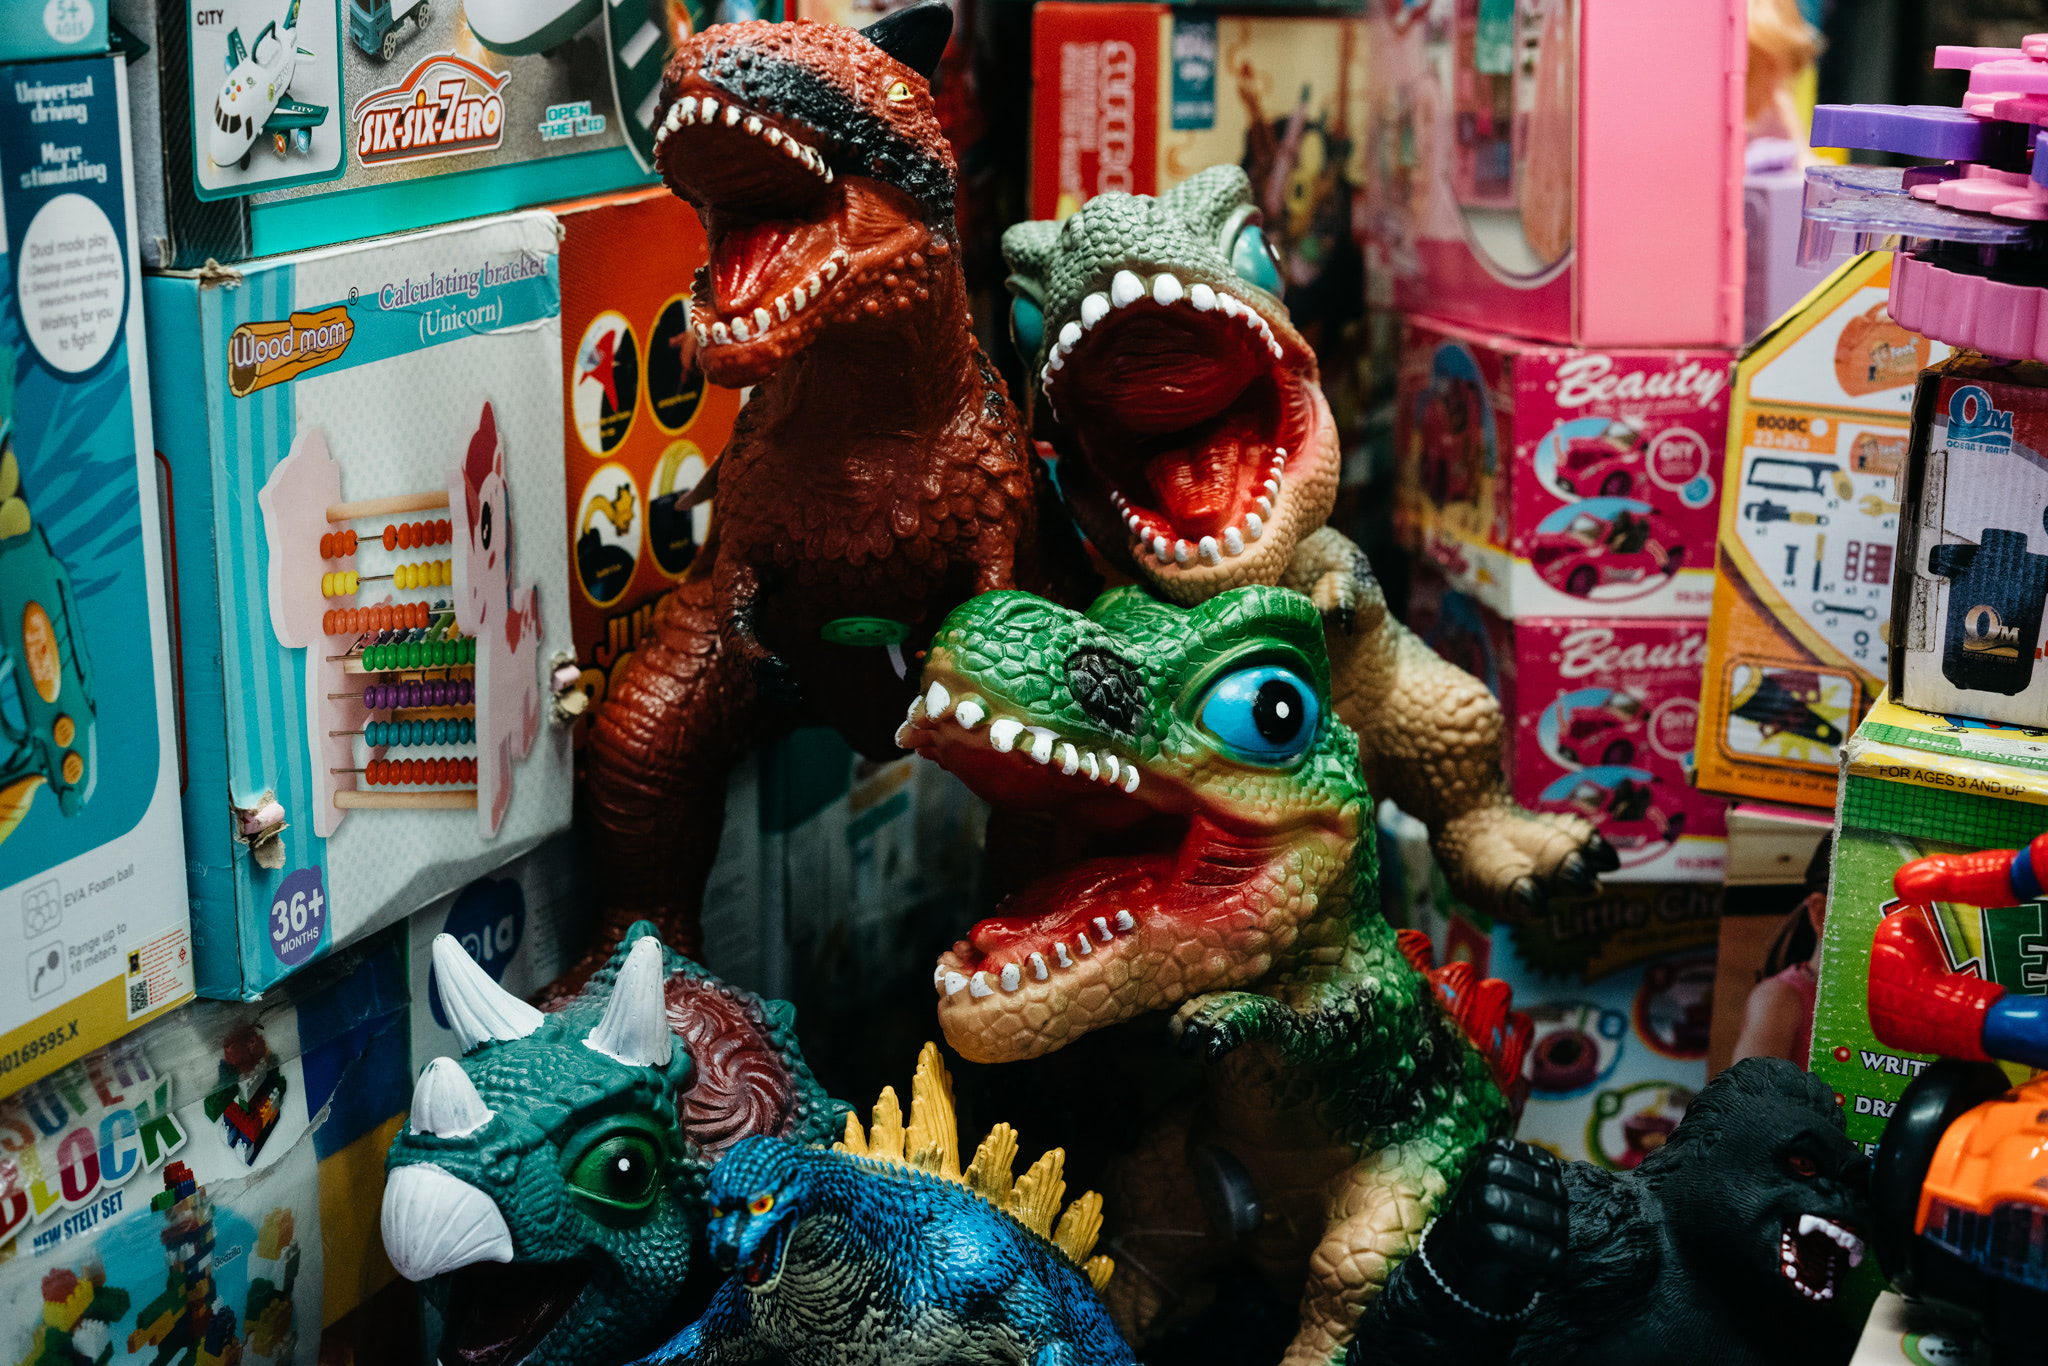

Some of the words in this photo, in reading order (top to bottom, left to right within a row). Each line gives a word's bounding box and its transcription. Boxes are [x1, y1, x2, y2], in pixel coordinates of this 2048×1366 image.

[197, 9, 224, 25] CITY
[15, 75, 94, 103] Universal
[30, 100, 88, 124] driving
[291, 105, 314, 113] CITY
[547, 104, 590, 121] OPEN
[541, 122, 571, 138] THE
[576, 118, 604, 133] LID
[41, 142, 82, 164] More
[21, 160, 107, 189] stimulating
[29, 239, 54, 259] Dual
[56, 234, 85, 254] mode
[87, 233, 108, 250] play
[379, 268, 480, 311] Calculating
[483, 251, 547, 288] bracket
[41, 313, 79, 332] Waiting
[97, 307, 114, 323] you
[419, 295, 503, 345] (Unicorn)
[234, 325, 295, 368] Wood
[299, 321, 346, 354] mom
[1556, 354, 1724, 408] Beauty
[1879, 766, 1910, 779] FOR
[1913, 770, 1955, 787] AGES
[1958, 776, 1966, 788] 3
[1969, 779, 2001, 794] AND
[2004, 785, 2026, 797] UP
[63, 891, 87, 908] EVA
[88, 877, 116, 897] Foam
[117, 863, 135, 881] ball
[271, 888, 325, 942] 36+
[68, 938, 100, 960] Range
[102, 930, 116, 949] up
[117, 922, 128, 935] to
[281, 926, 320, 956] MONTHS
[70, 962, 82, 975] 10
[84, 944, 118, 971] meters
[1859, 1050, 1932, 1078] WRIT
[102, 1190, 124, 1219] SET
